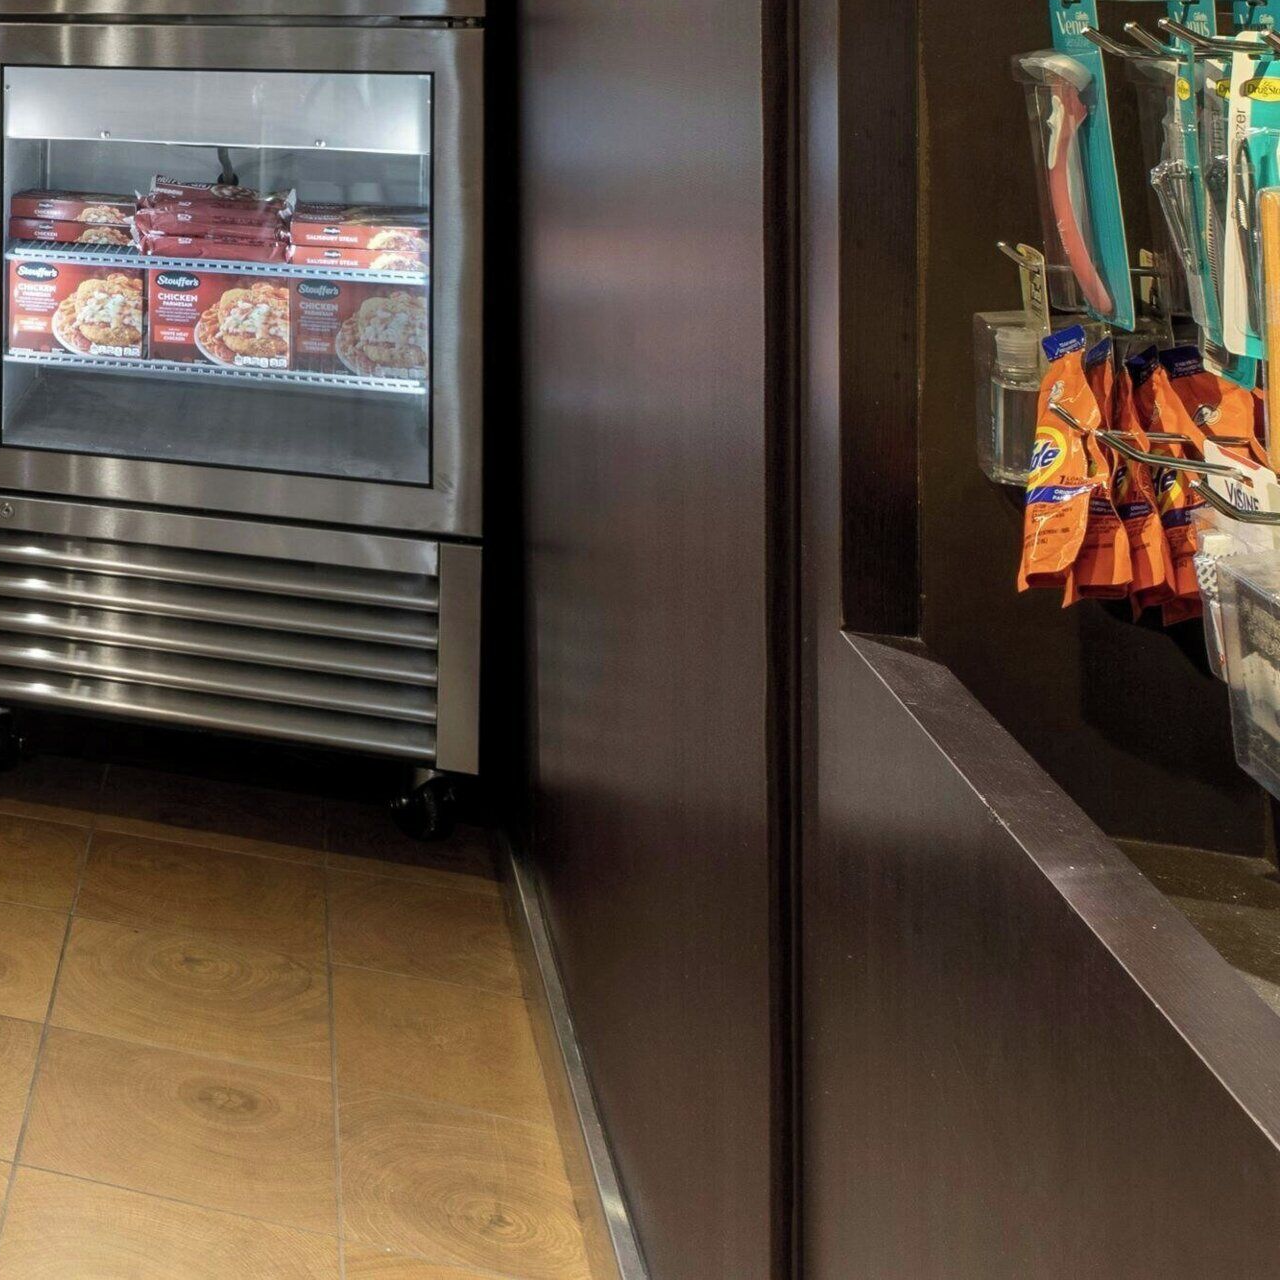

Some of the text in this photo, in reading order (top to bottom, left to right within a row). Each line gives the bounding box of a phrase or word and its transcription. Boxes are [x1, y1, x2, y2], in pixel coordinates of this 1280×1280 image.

[156, 274, 200, 290] Stouffer's
[297, 283, 340, 297] Stouffer's
[157, 293, 198, 302] CHICKEN
[299, 302, 339, 312] CHICKEN
